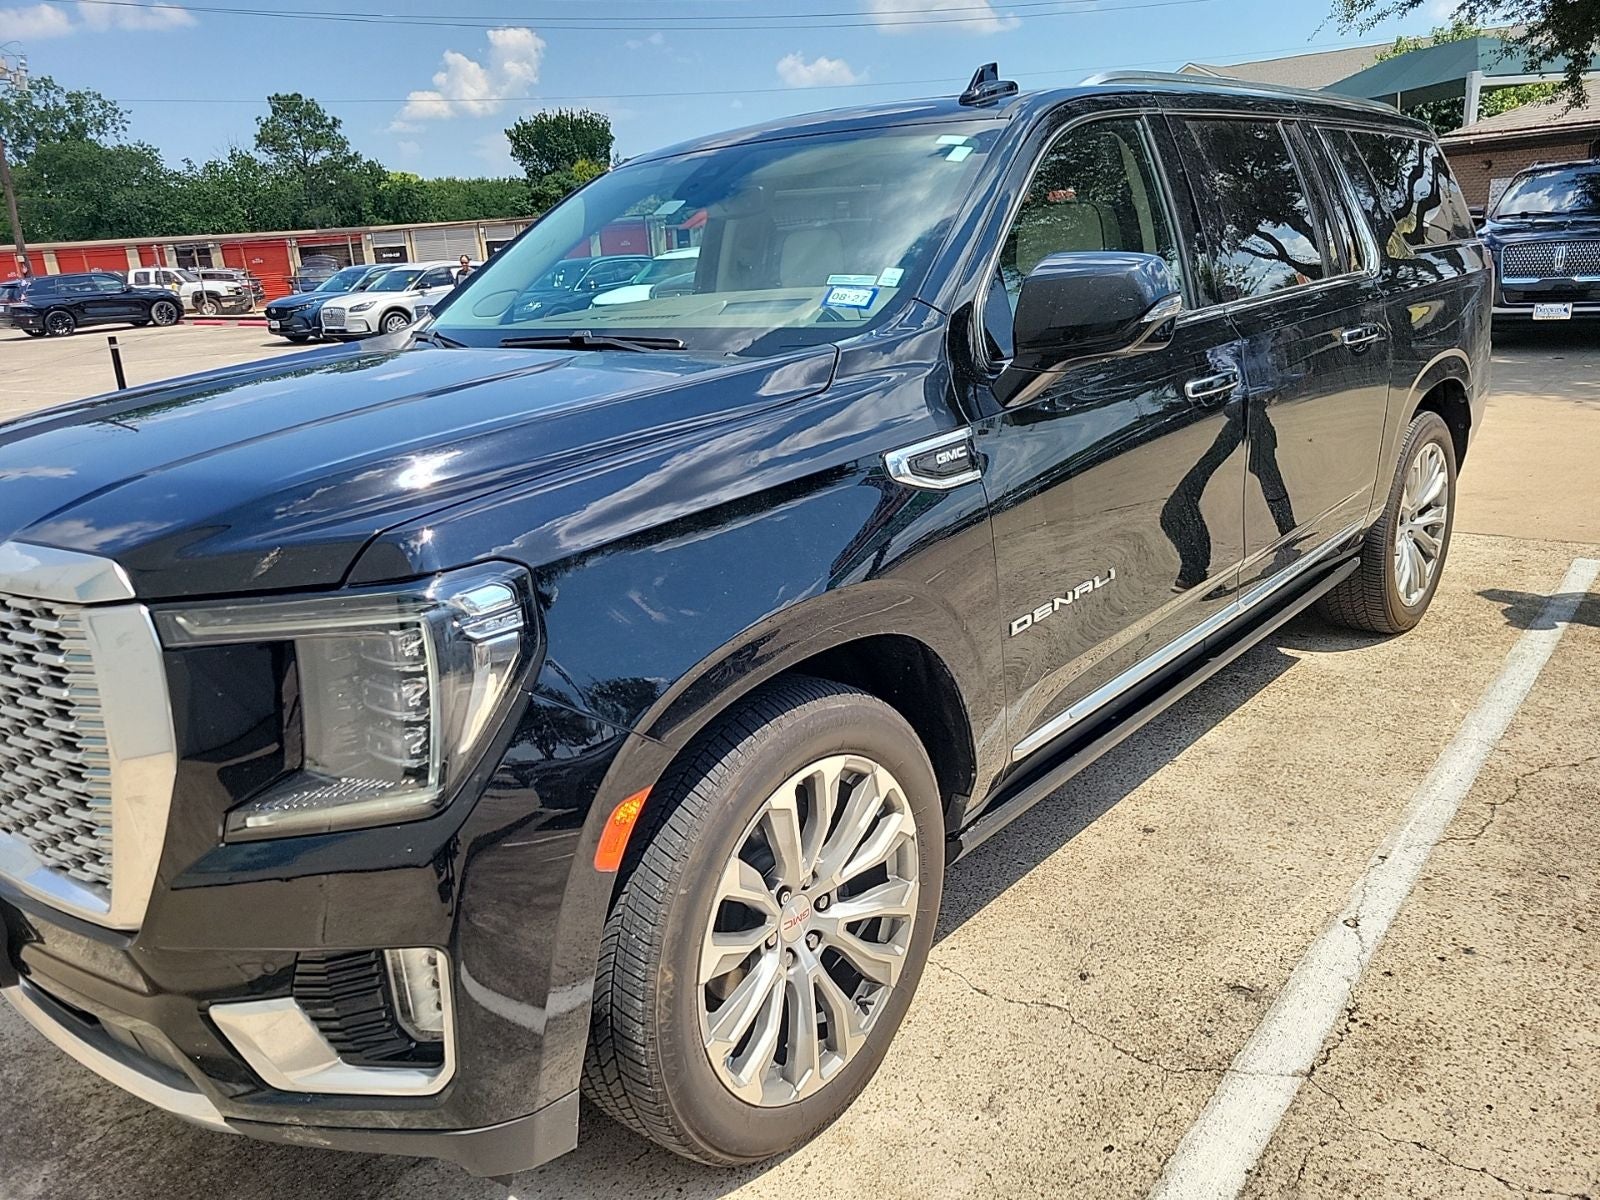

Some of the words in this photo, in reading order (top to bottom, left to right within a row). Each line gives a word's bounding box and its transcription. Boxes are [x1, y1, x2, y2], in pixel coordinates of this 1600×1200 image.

[936, 445, 968, 465] GMC
[1009, 567, 1116, 637] DENALI
[485, 614, 518, 630] GMC
[783, 908, 810, 931] GMC
